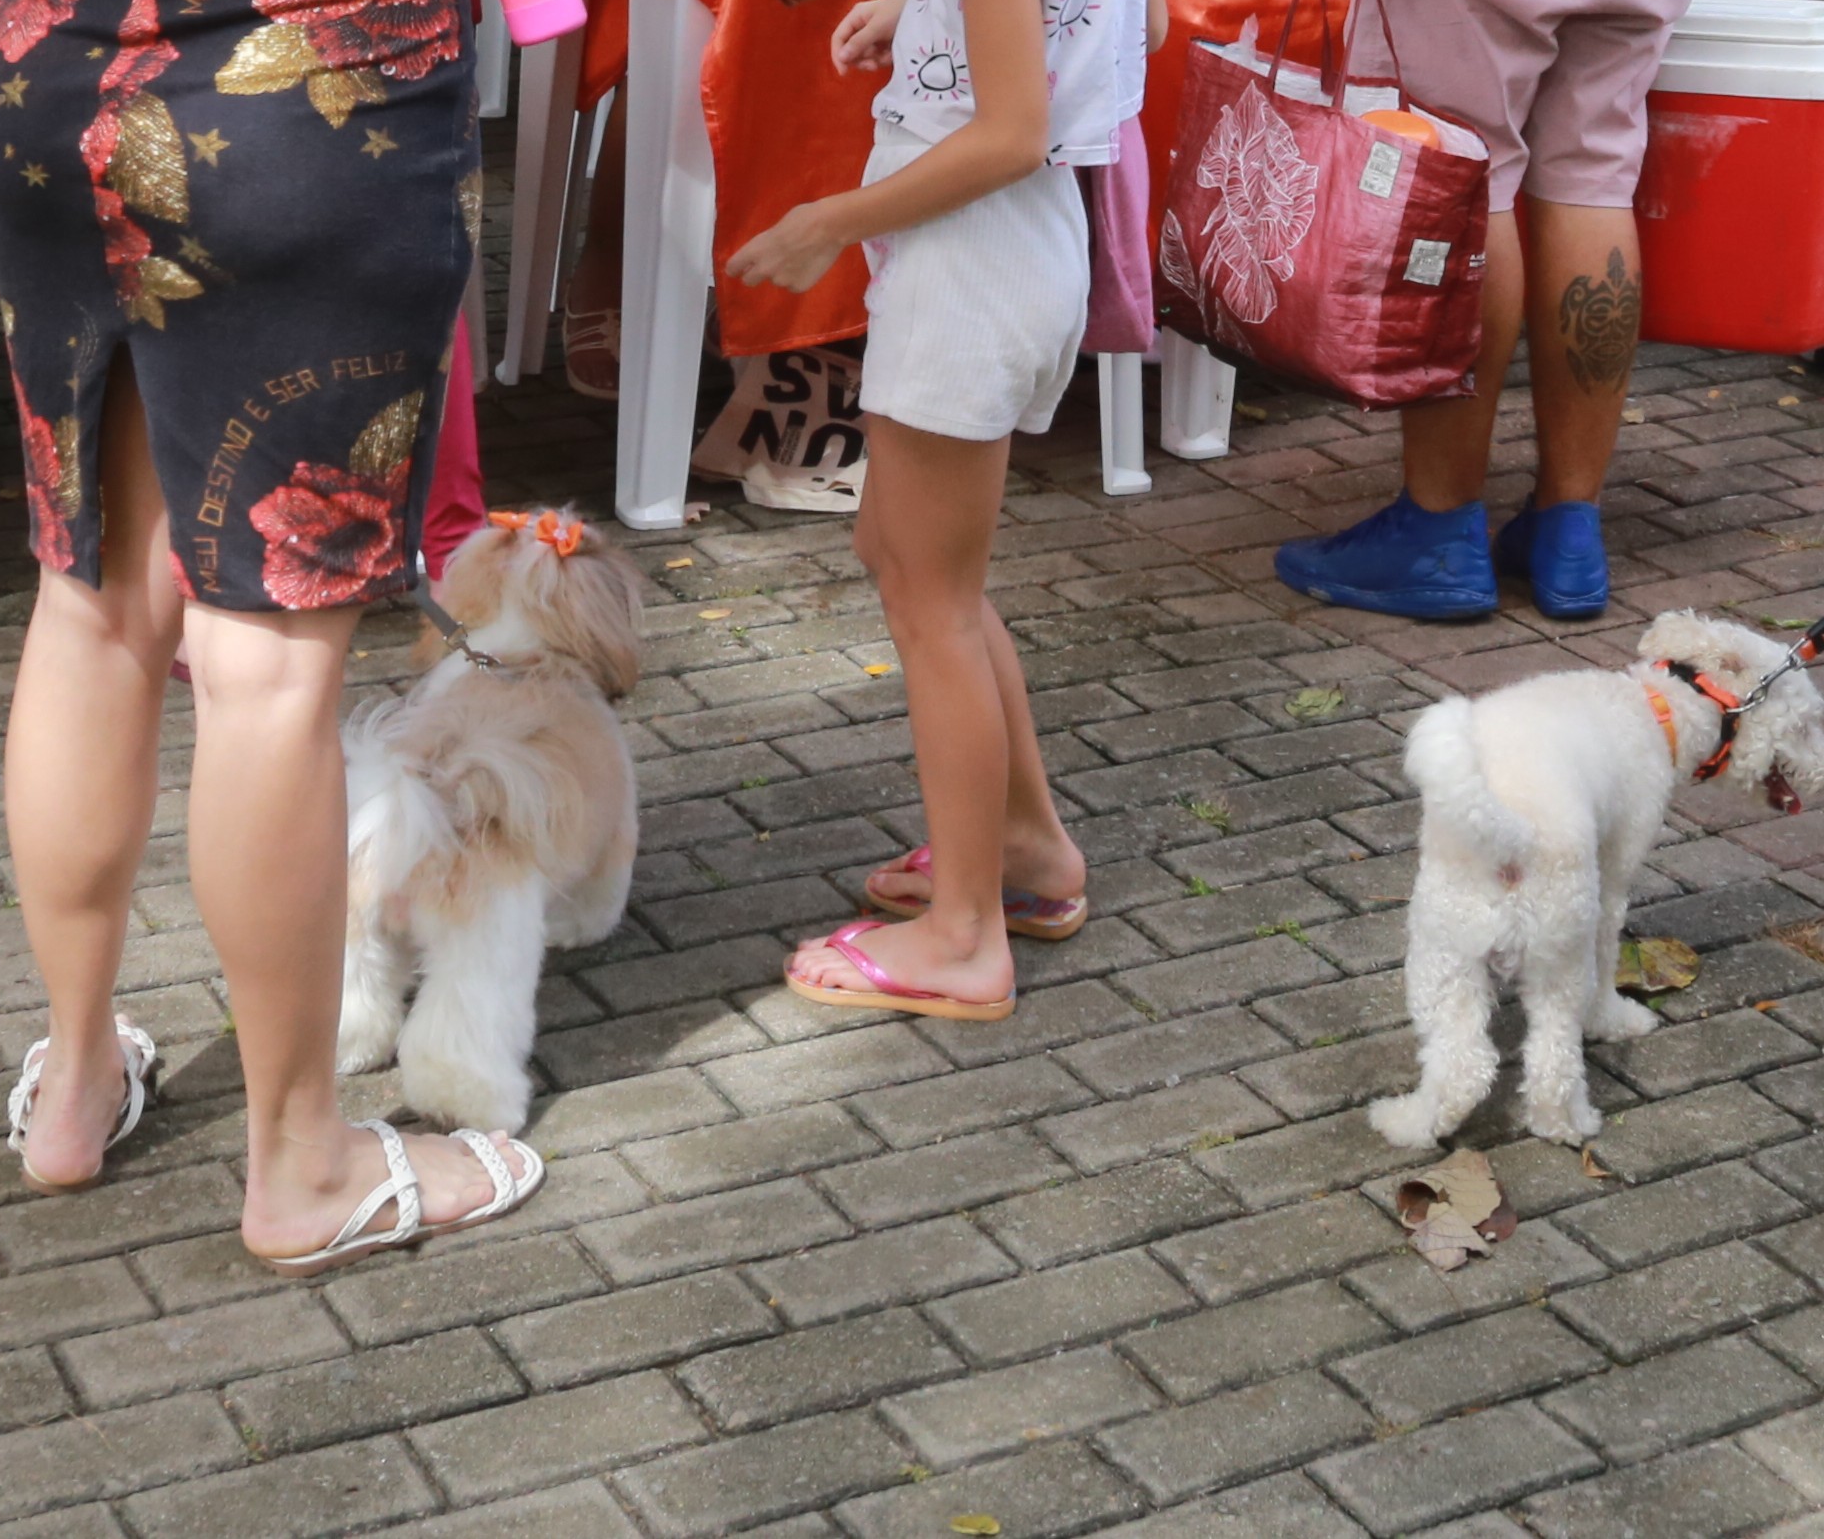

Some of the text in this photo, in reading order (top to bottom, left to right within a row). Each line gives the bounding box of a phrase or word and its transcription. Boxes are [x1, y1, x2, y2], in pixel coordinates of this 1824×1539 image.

[264, 368, 322, 404] SER
[331, 350, 407, 380] FELIZ
[197, 419, 255, 527] DESTINO
[193, 536, 221, 593] MEU
